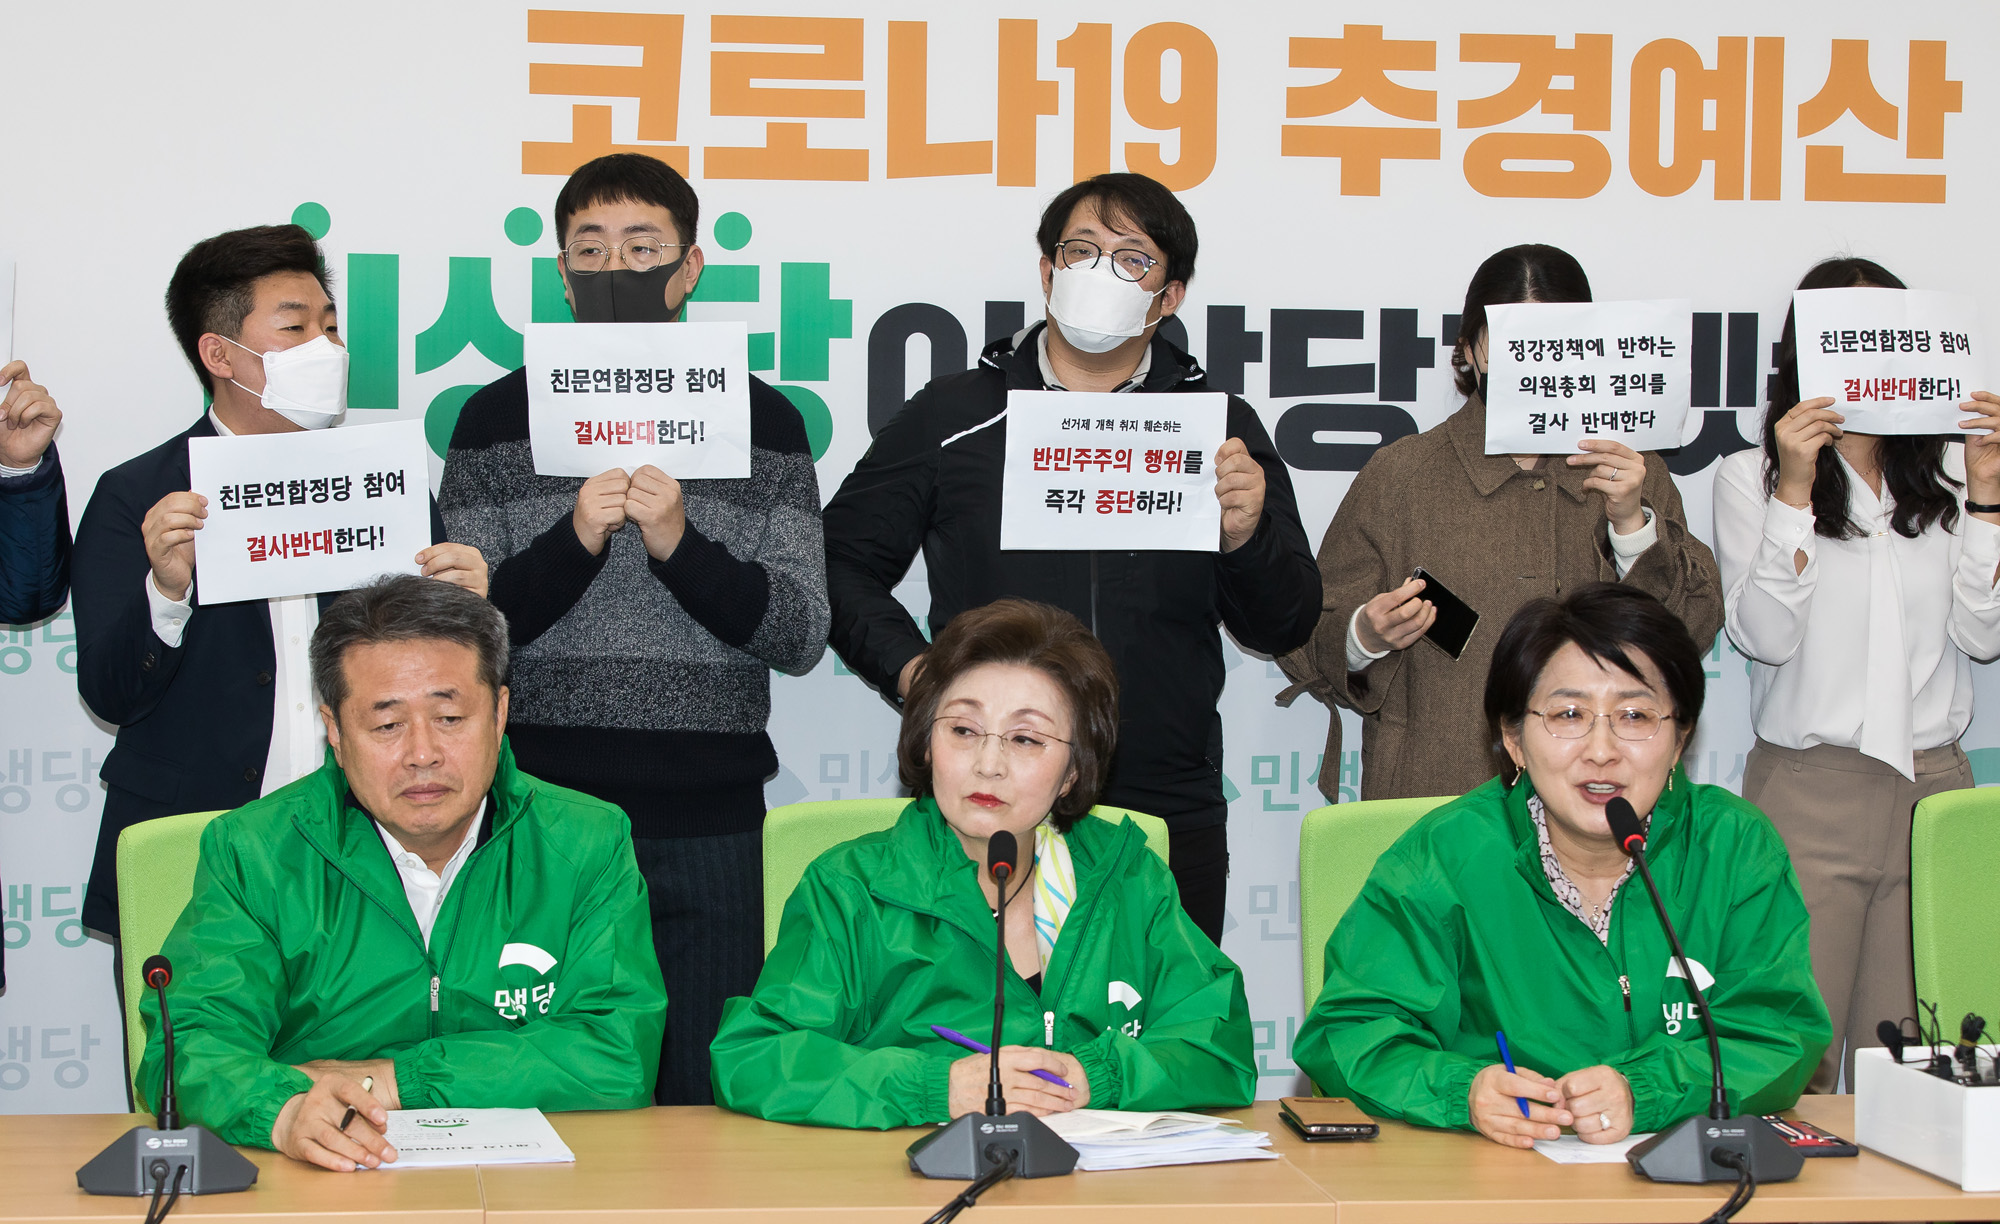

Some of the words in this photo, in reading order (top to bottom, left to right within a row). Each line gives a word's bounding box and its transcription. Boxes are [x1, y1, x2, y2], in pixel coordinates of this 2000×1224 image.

[520, 8, 1222, 194] 코로나19
[1280, 22, 1964, 205] 추경예산
[1508, 337, 1605, 363] 정강정책에
[1617, 335, 1677, 360] 반하는
[1819, 328, 1932, 354] 친문연합정당
[1938, 330, 1972, 356] 참여
[550, 367, 676, 394] 친문연합정당
[685, 367, 726, 394] 참여
[1518, 374, 1596, 399] 의원총회
[1609, 372, 1667, 397] 결의를
[1843, 377, 1962, 402] 결사반대한다!
[574, 419, 705, 446] 결사반대한다!
[1061, 417, 1091, 431] 선거제
[1094, 418, 1115, 432] 개혁
[1118, 419, 1139, 433] 취지
[1142, 419, 1182, 433] 훼손하는
[1527, 412, 1570, 435] 결사
[1581, 409, 1657, 435] 반대한다
[1032, 446, 1133, 474] 반민주주의
[1144, 448, 1204, 475] 행위를
[219, 474, 353, 511] 친문연합정당
[362, 469, 406, 500] 참여
[1044, 488, 1086, 515] 즉각
[1095, 489, 1183, 516] 중단하라!
[246, 525, 385, 563] 결사반대한다!
